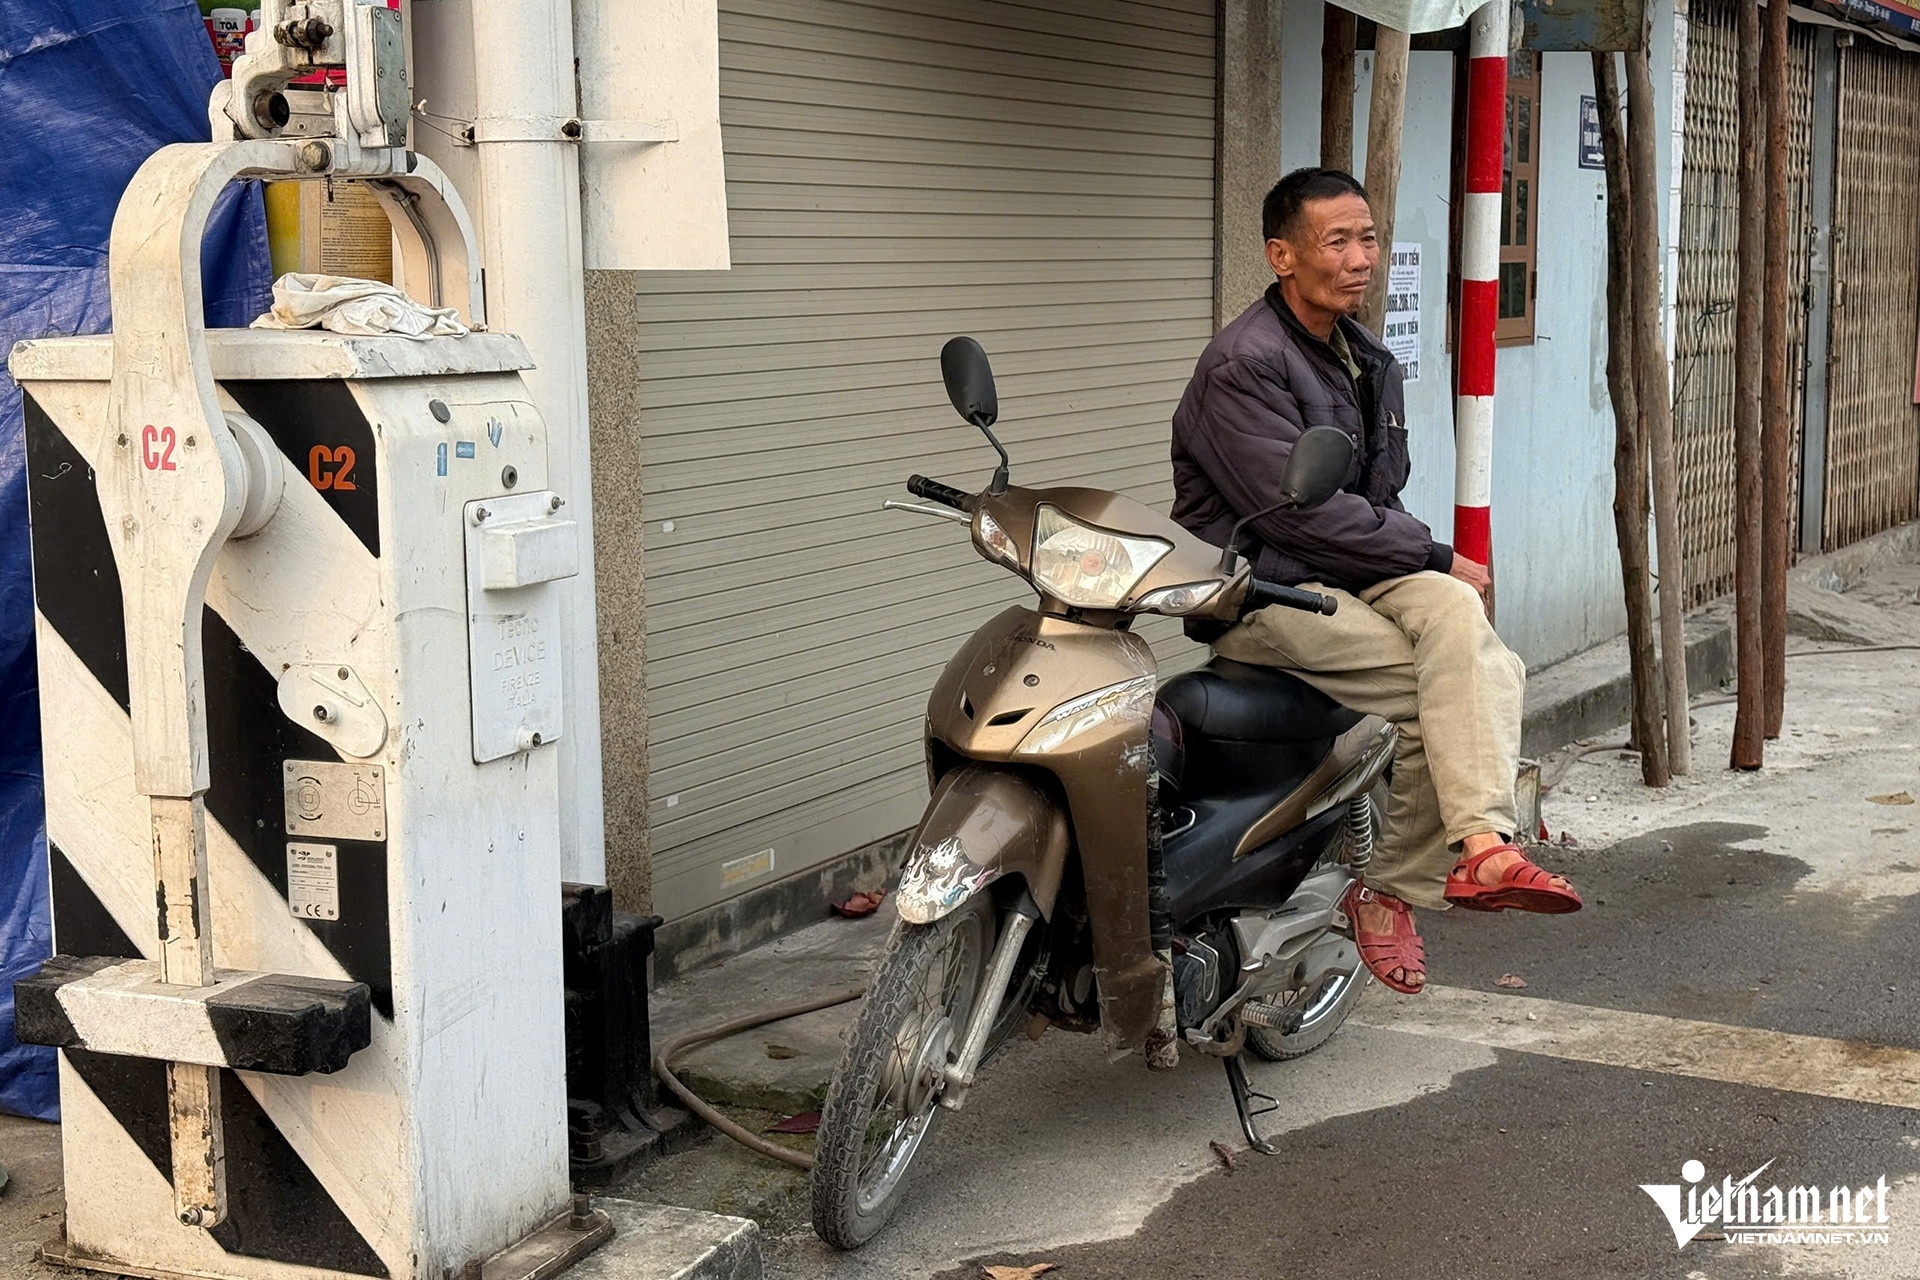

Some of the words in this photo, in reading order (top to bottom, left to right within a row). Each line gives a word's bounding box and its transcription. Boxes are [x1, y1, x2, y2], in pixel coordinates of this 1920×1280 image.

[220, 22, 239, 30] TOA
[1386, 323, 1396, 338] CHO
[1397, 322, 1407, 336] VAY
[142, 424, 176, 471] C2
[309, 444, 356, 490] C2
[1007, 635, 1057, 651] HONDA
[493, 641, 546, 672] DEVICE
[500, 671, 540, 694] FIRENZE
[506, 690, 537, 712] ITALIA
